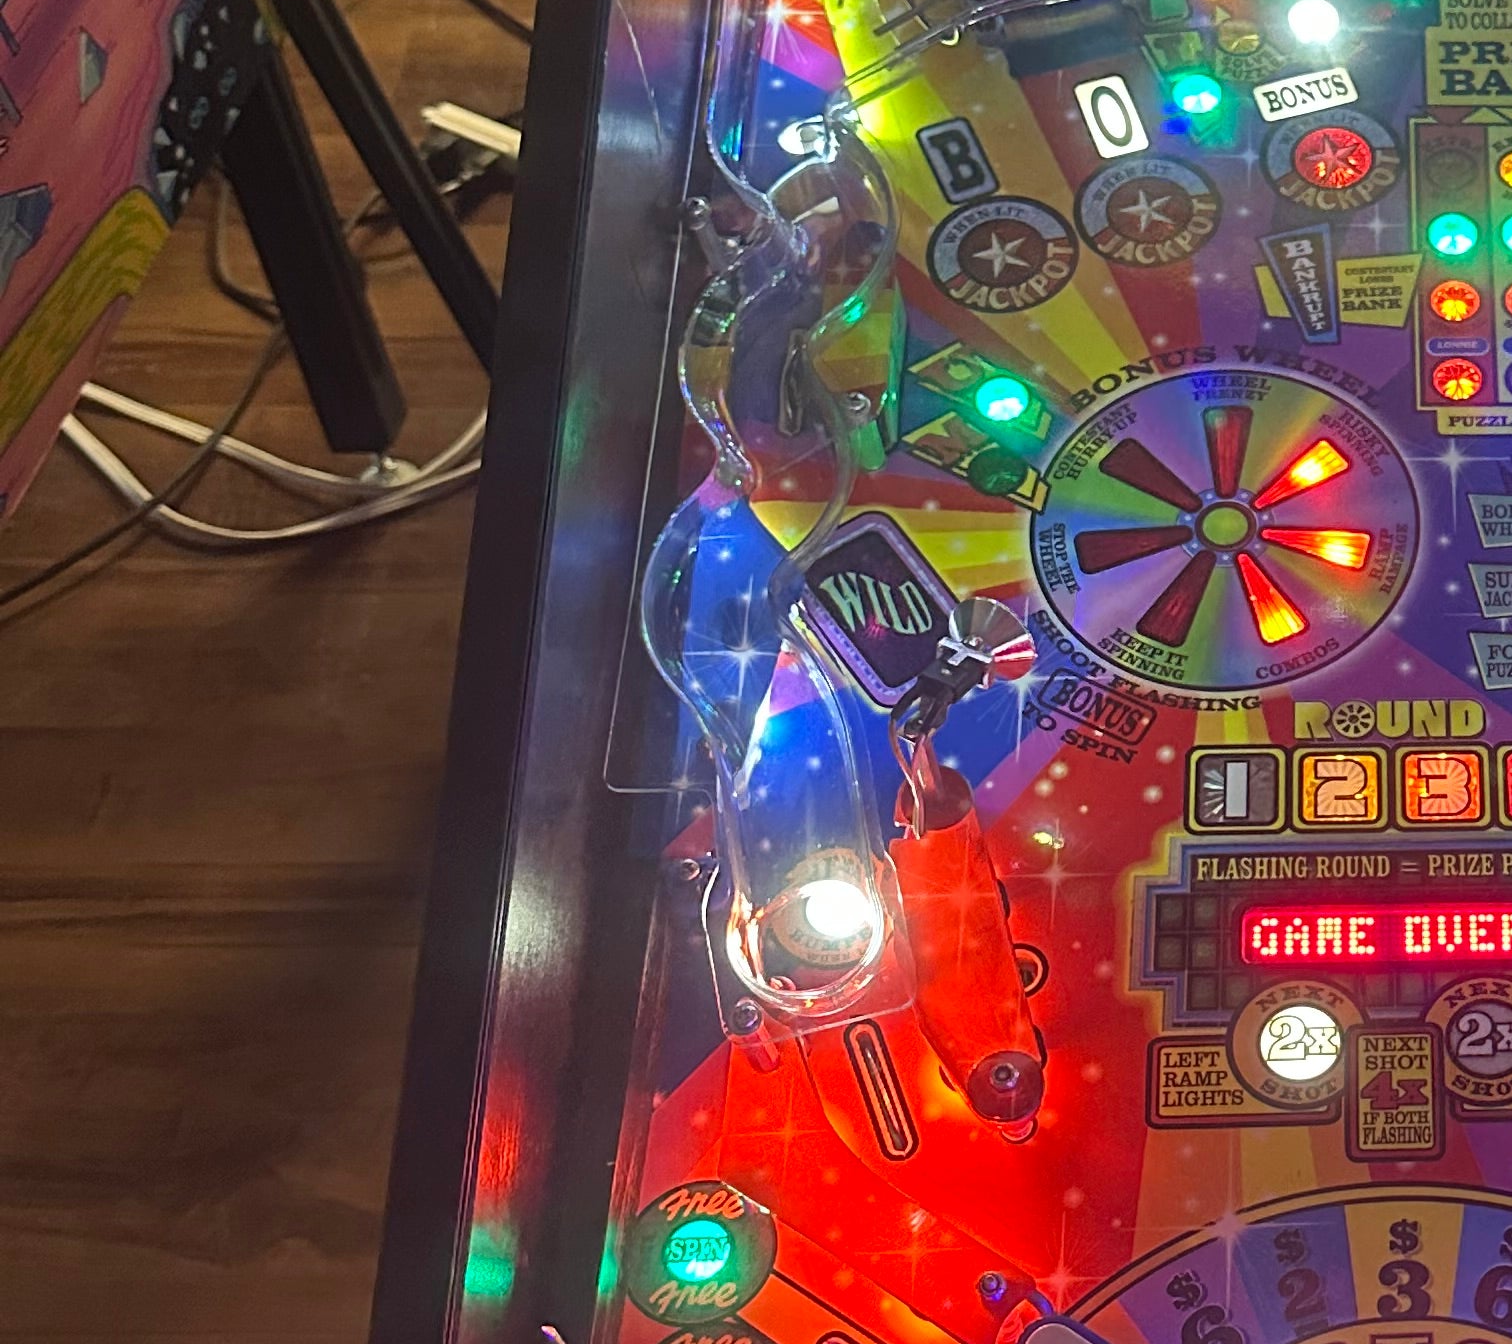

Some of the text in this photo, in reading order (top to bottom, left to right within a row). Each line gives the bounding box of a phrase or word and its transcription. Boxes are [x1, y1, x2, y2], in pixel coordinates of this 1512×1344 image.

[1445, 12, 1468, 30] TO
[1262, 74, 1349, 113] BONUS
[1090, 86, 1133, 147] O
[930, 129, 985, 191] B
[1279, 147, 1400, 211] JACKPOT
[1094, 162, 1170, 203] WHEN LIT
[943, 206, 1026, 245] WHEN LIT
[1097, 197, 1217, 265] JACKPOT
[950, 242, 1075, 310] JACKPOT
[1282, 239, 1327, 330] BANKRUPT
[1342, 286, 1403, 298] PRIZE
[1342, 298, 1403, 311] BANK
[1070, 344, 1384, 415] BONUS WHEEL
[1192, 375, 1271, 391] WHEEL
[1053, 403, 1133, 481] CONTESTANT
[1067, 411, 1138, 481] HURRY-UP
[1318, 413, 1384, 478] SPINNING
[1339, 410, 1391, 458] RISKY
[1052, 523, 1069, 555] STOP
[1039, 530, 1061, 593] WHEEL
[818, 571, 933, 636] WILD
[1034, 609, 1263, 713] SHOOT FLASHING
[1097, 637, 1184, 681] SPINNING
[1111, 627, 1189, 667] KEEP IT
[1255, 637, 1340, 680] COMBOS
[1051, 677, 1145, 739] BONUS
[1060, 726, 1140, 763] SPIN
[1223, 760, 1249, 819] 1
[1315, 757, 1369, 818] 2
[1417, 757, 1472, 817] 3
[1196, 854, 1309, 880] FLASHING
[1315, 854, 1391, 879] ROUND
[1428, 854, 1495, 877] PRIZE
[1251, 917, 1376, 956] GAME
[1253, 985, 1346, 1012] NEXT
[1266, 1014, 1342, 1062] 2x
[1363, 1036, 1430, 1053] NEXT
[1162, 1051, 1222, 1069] LEFT
[1162, 1070, 1229, 1088] RAMP
[1364, 1054, 1430, 1072] SHOT
[1162, 1089, 1245, 1108] LIGHTS
[1260, 1076, 1340, 1103] SHOT
[1360, 1071, 1430, 1109] 4x
[1362, 1125, 1432, 1146] FLASHING
[1363, 1111, 1429, 1125] IF BOTH
[659, 1188, 745, 1221] Free
[667, 1237, 729, 1262] SPIN
[650, 1281, 738, 1313] Free
